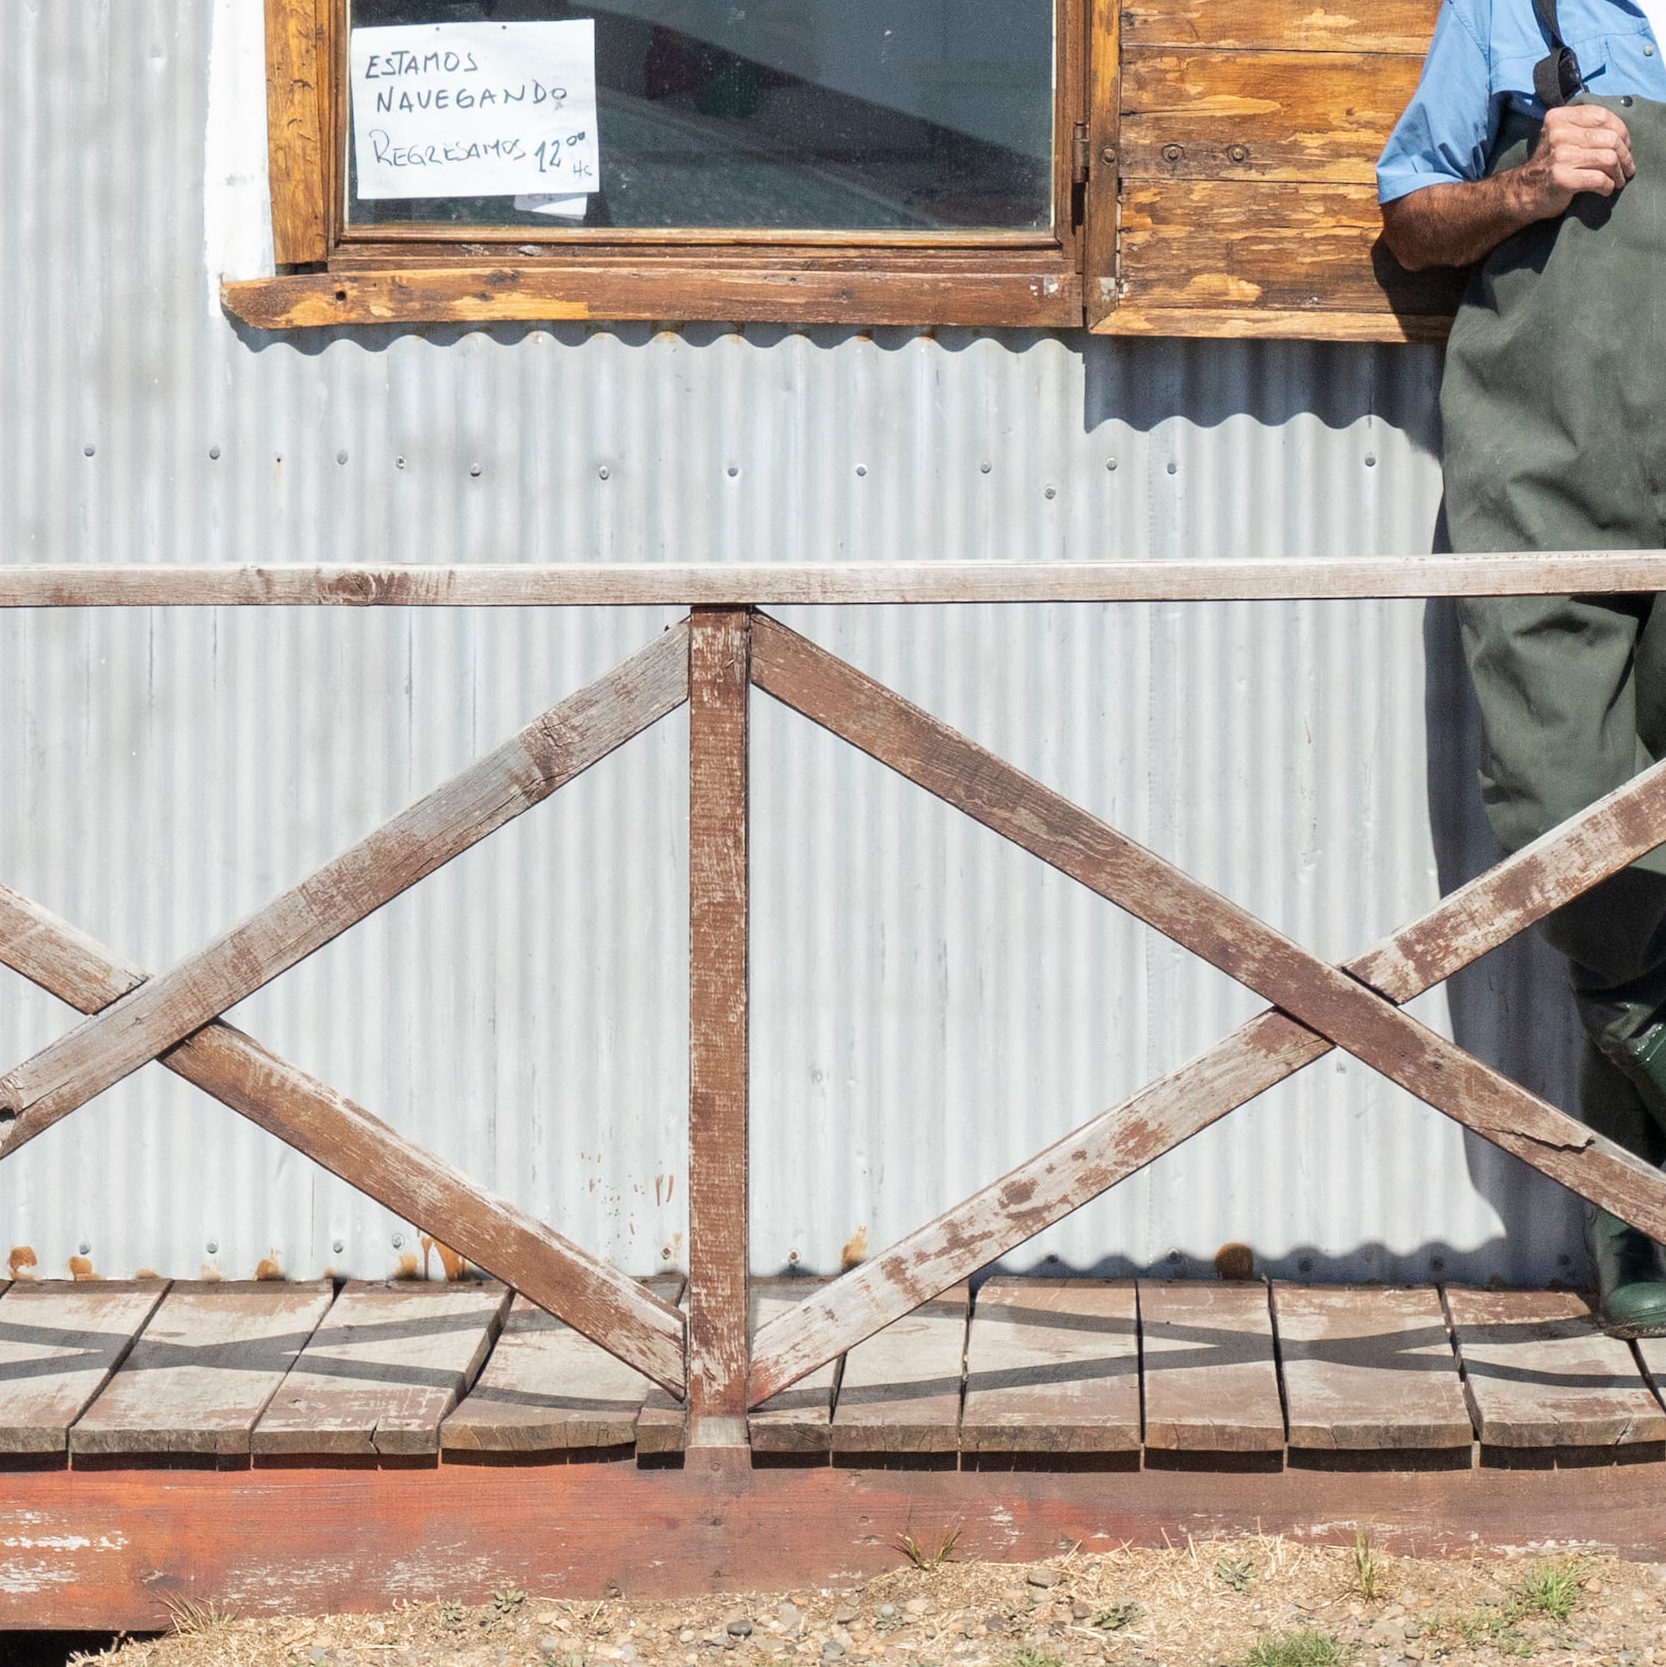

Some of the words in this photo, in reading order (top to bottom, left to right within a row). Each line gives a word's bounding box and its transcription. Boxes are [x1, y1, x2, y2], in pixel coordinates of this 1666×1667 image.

[365, 50, 479, 79] ESTAMOS
[376, 79, 568, 114] NAVEGANDO
[368, 129, 526, 167] REGRESAMOS
